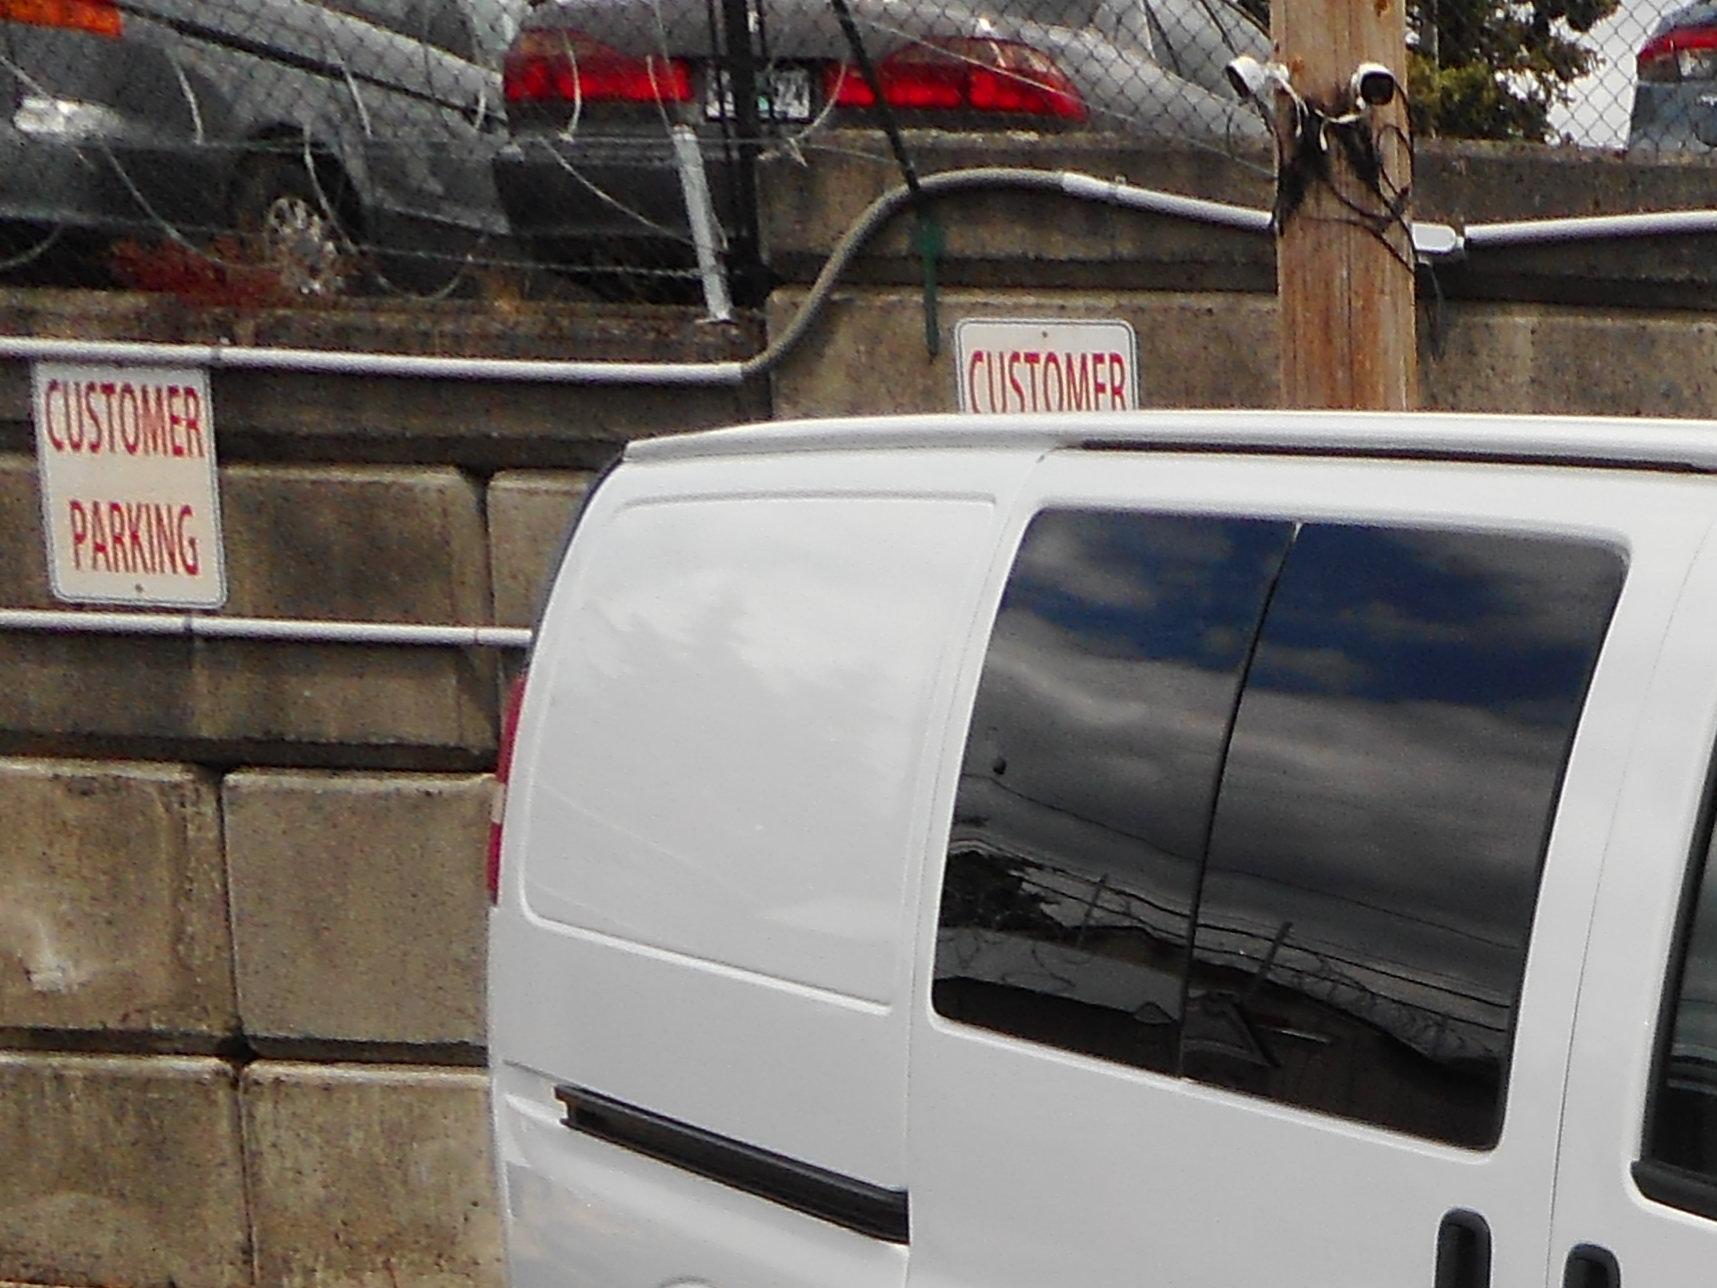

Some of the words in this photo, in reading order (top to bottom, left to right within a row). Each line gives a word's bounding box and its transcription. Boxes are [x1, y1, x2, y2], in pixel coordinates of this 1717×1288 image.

[46, 379, 205, 458] CUSTOMER
[968, 350, 1127, 413] CUSTOMER
[69, 500, 201, 576] PARKING
